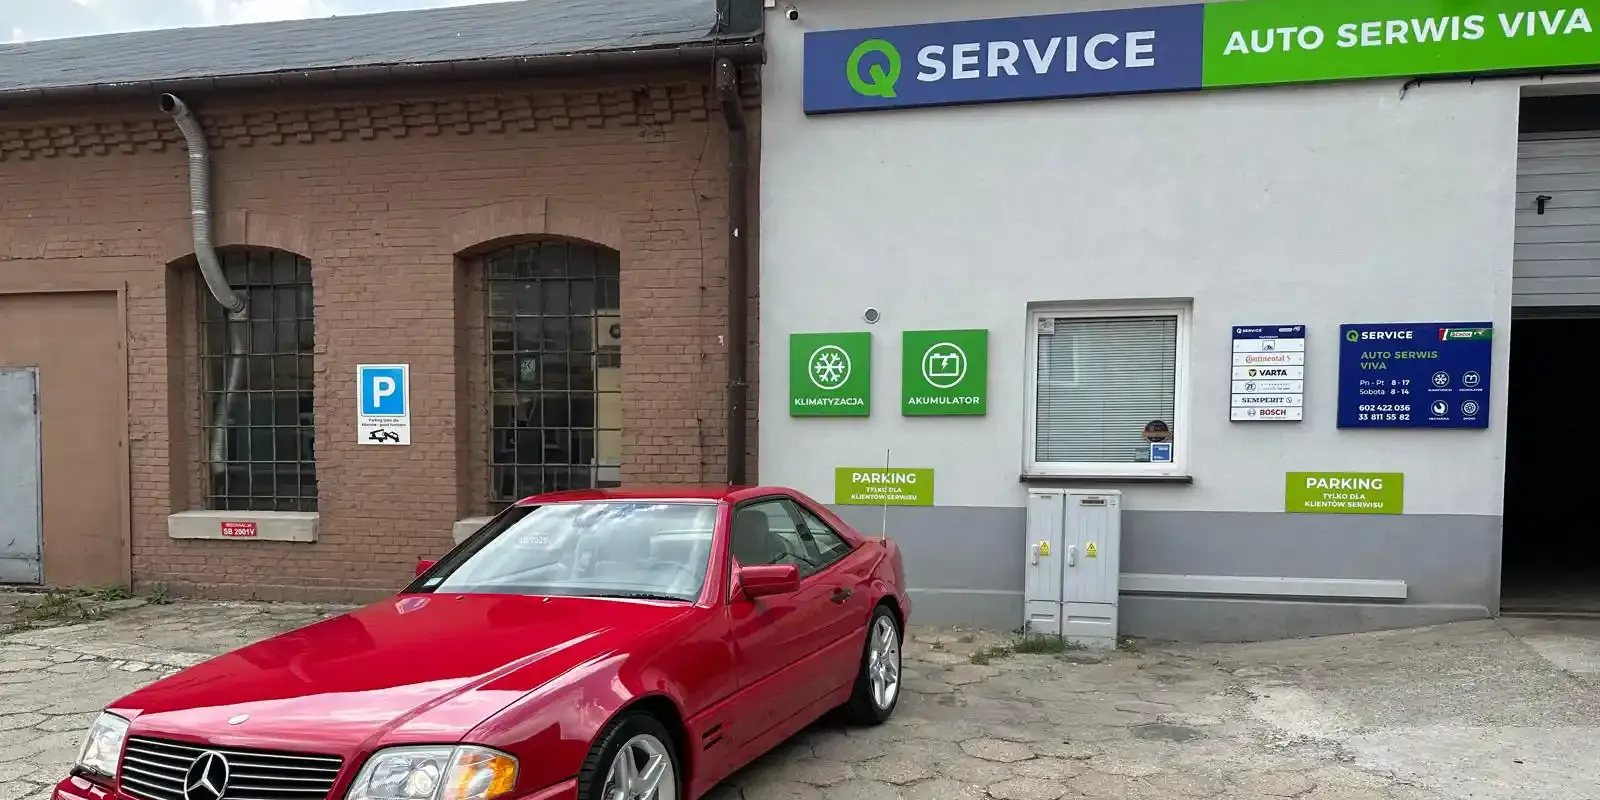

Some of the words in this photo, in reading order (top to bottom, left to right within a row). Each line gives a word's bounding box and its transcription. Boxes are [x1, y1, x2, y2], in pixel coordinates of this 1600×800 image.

[1222, 25, 1325, 56] AUTO
[1335, 14, 1485, 48] SERWIS
[1497, 7, 1593, 38] VIVA
[846, 38, 901, 98] Q
[916, 30, 1156, 82] SERVICE
[1346, 329, 1359, 342] Q
[1361, 331, 1413, 340] SERVICE
[1245, 354, 1285, 364] Continental
[1360, 351, 1391, 359] AUTO
[1394, 350, 1438, 359] SERWIS
[1360, 362, 1387, 370] VIVA
[373, 376, 396, 408] P
[794, 397, 865, 406] KLIMATYZACJA
[908, 396, 980, 405] AKUMULATOR
[1358, 413, 1368, 421] 33
[1371, 413, 1383, 421] 811
[1386, 413, 1396, 421] 55
[1399, 413, 1410, 421] 82
[852, 472, 917, 484] PARKING
[1306, 477, 1383, 490] PARKING
[1304, 500, 1345, 508] KLIENTÓW
[1347, 501, 1384, 509] SERWISU
[223, 527, 233, 535] SB
[234, 528, 255, 536] 2001V
